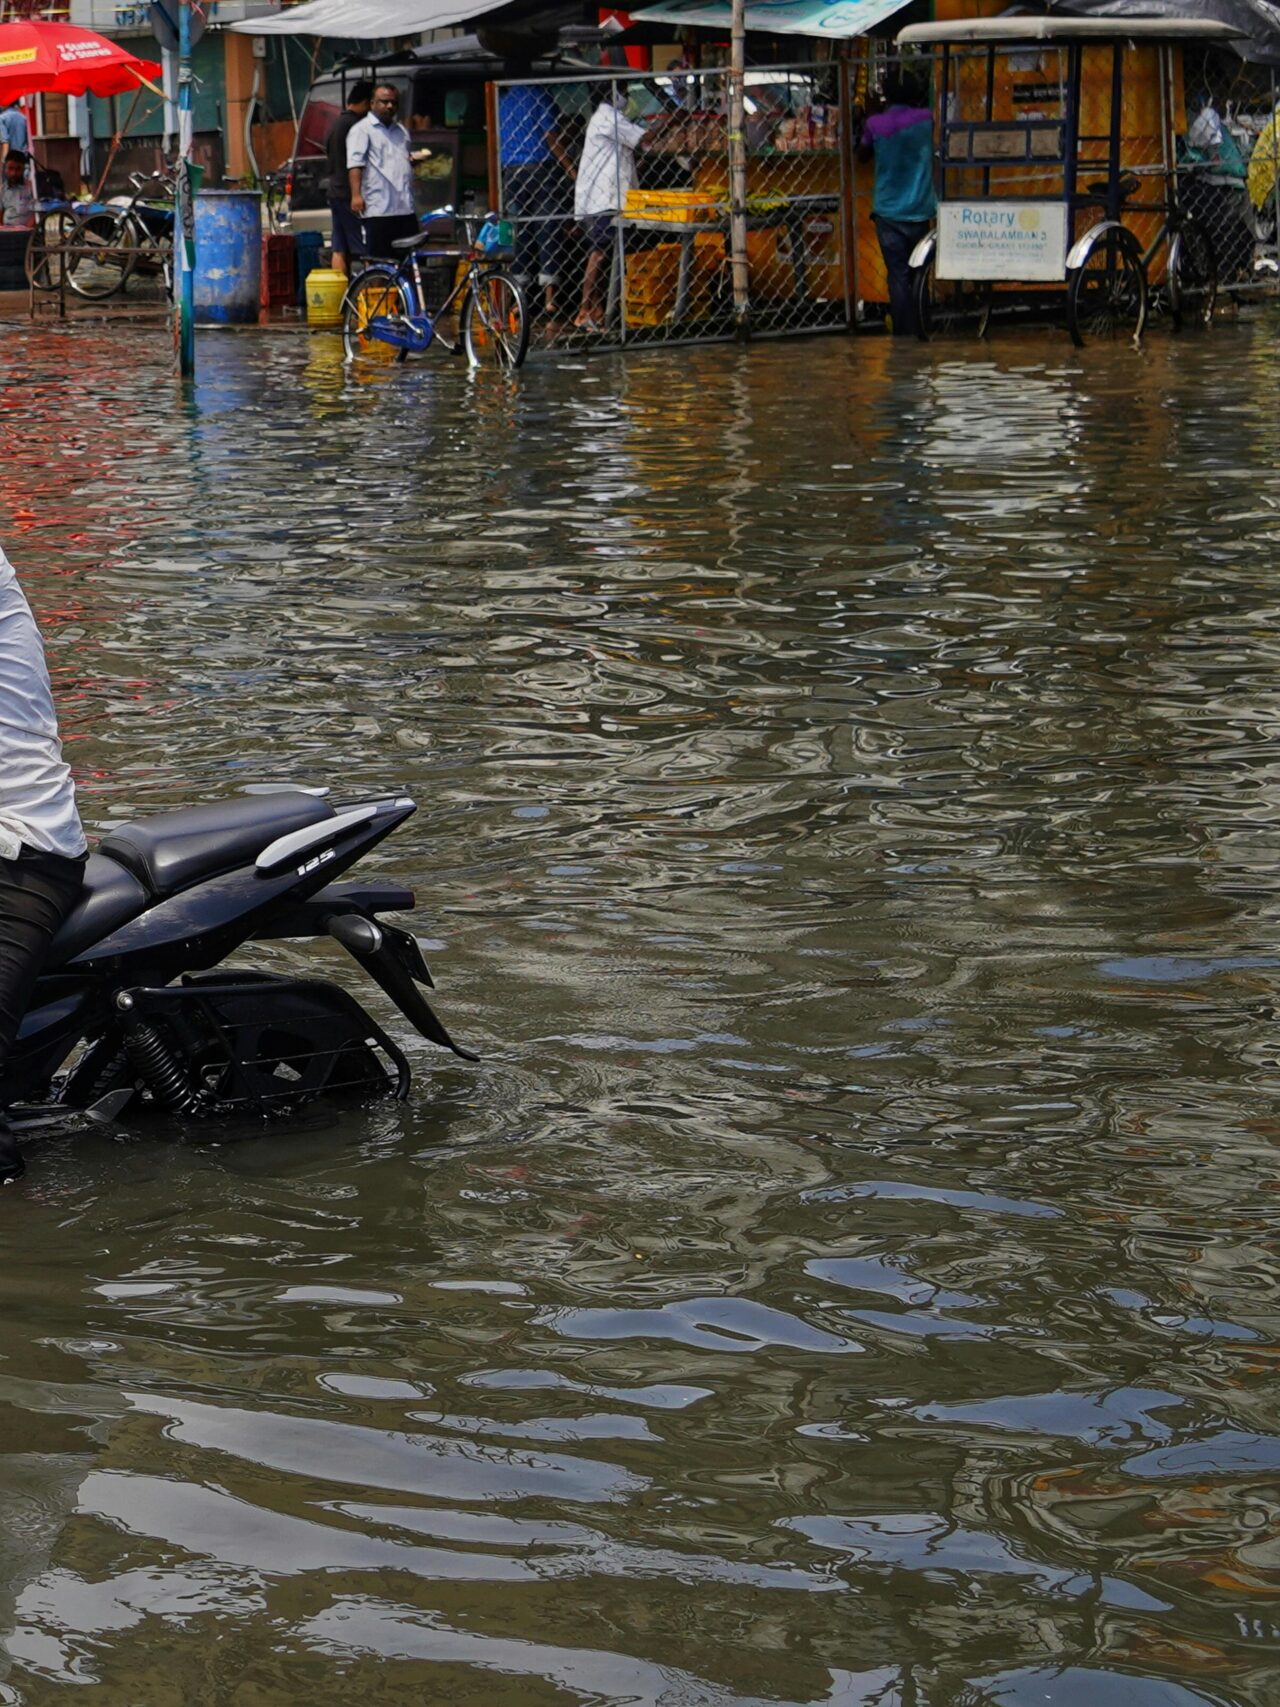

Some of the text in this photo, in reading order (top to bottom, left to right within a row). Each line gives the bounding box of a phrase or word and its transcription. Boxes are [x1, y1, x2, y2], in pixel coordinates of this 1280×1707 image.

[64, 41, 101, 52] States
[75, 48, 112, 59] Stores
[962, 208, 1015, 227] Rotary
[297, 848, 336, 876] 125
